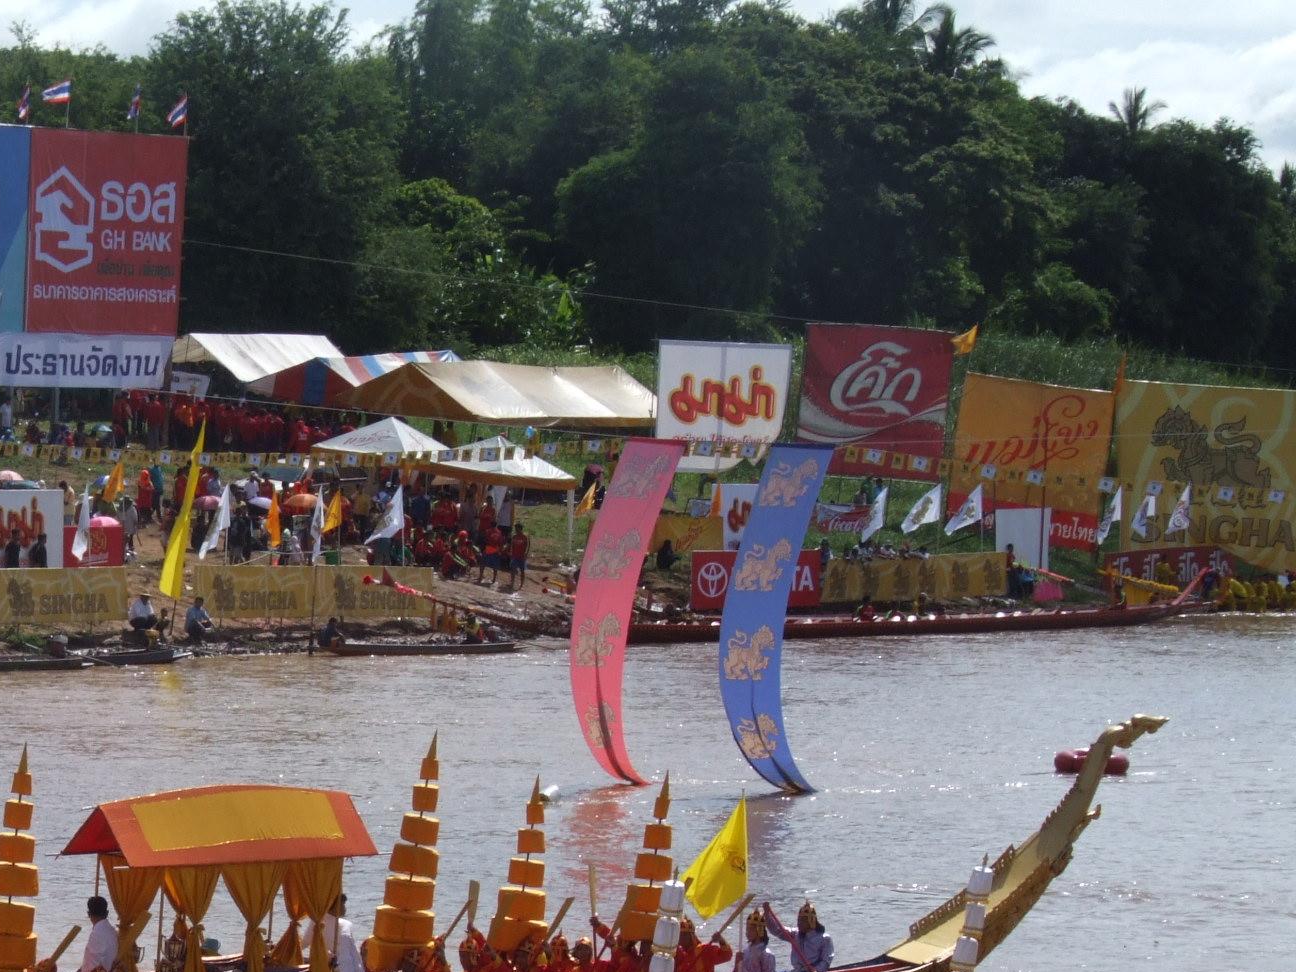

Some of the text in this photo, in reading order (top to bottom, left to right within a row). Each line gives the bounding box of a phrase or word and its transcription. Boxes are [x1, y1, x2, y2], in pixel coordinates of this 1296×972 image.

[101, 181, 176, 223] ธอส
[101, 229, 172, 252] GH BANK
[6, 344, 160, 377] ประธานจัดงาน
[670, 366, 776, 426] มาม่า
[39, 593, 109, 615] SINGHA
